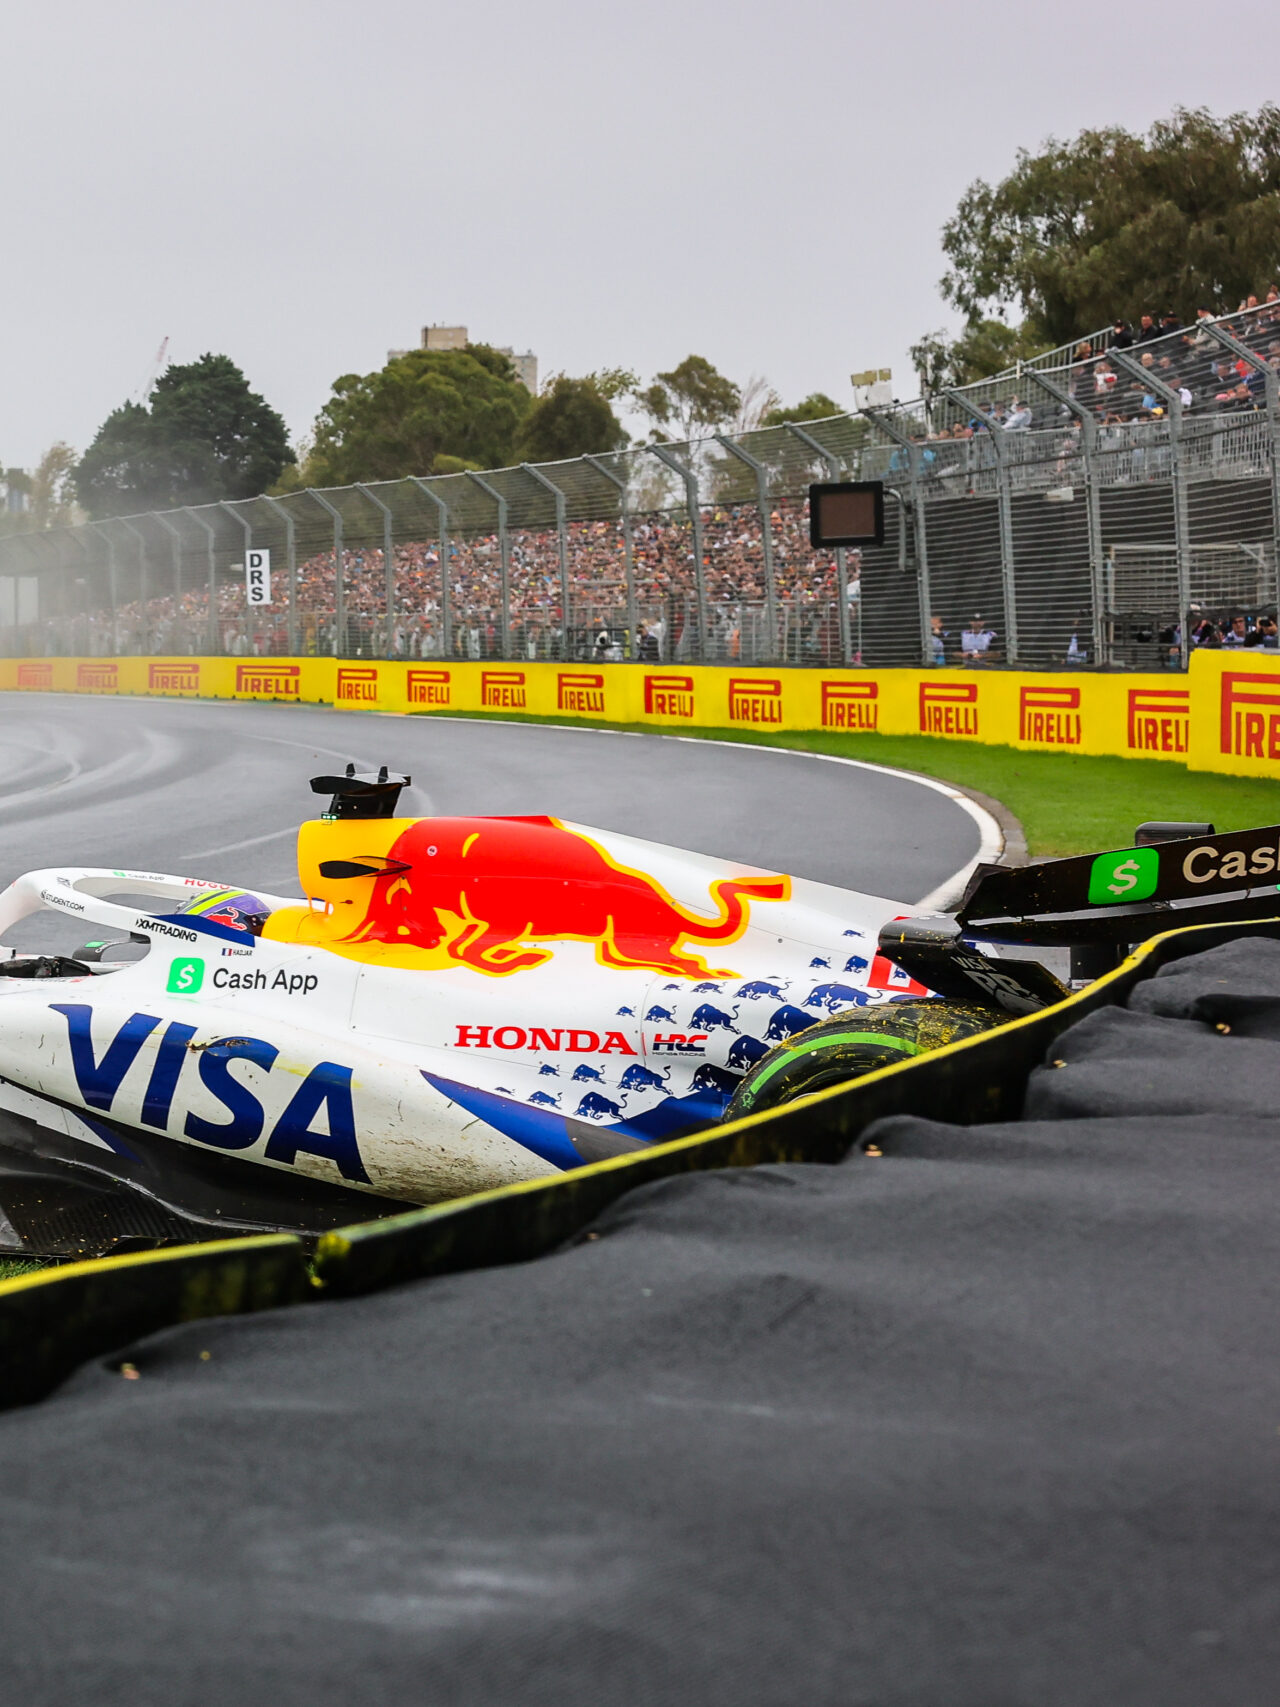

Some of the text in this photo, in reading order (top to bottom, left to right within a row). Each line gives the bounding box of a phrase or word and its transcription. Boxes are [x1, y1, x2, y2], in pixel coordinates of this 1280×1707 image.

[249, 553, 264, 602] DRS
[149, 663, 200, 689] PIRELLI
[236, 665, 300, 694] PIRELLI
[337, 668, 378, 701] PIRELLI
[407, 669, 451, 705] PIRELLI
[481, 671, 526, 708] PIRELLI
[557, 673, 605, 712] PIRELLI
[643, 675, 694, 718] PIRELLI
[728, 678, 782, 723] PIRELLI
[821, 680, 879, 729] PIRELLI
[919, 682, 979, 735] PIRELLI
[1019, 685, 1082, 744] PIRELLI
[1182, 836, 1280, 884] Cas
[213, 967, 267, 990] Cash
[271, 969, 319, 995] App
[454, 1025, 638, 1056] HONDA
[652, 1033, 708, 1052] HRC
[48, 1003, 374, 1185] VISA
